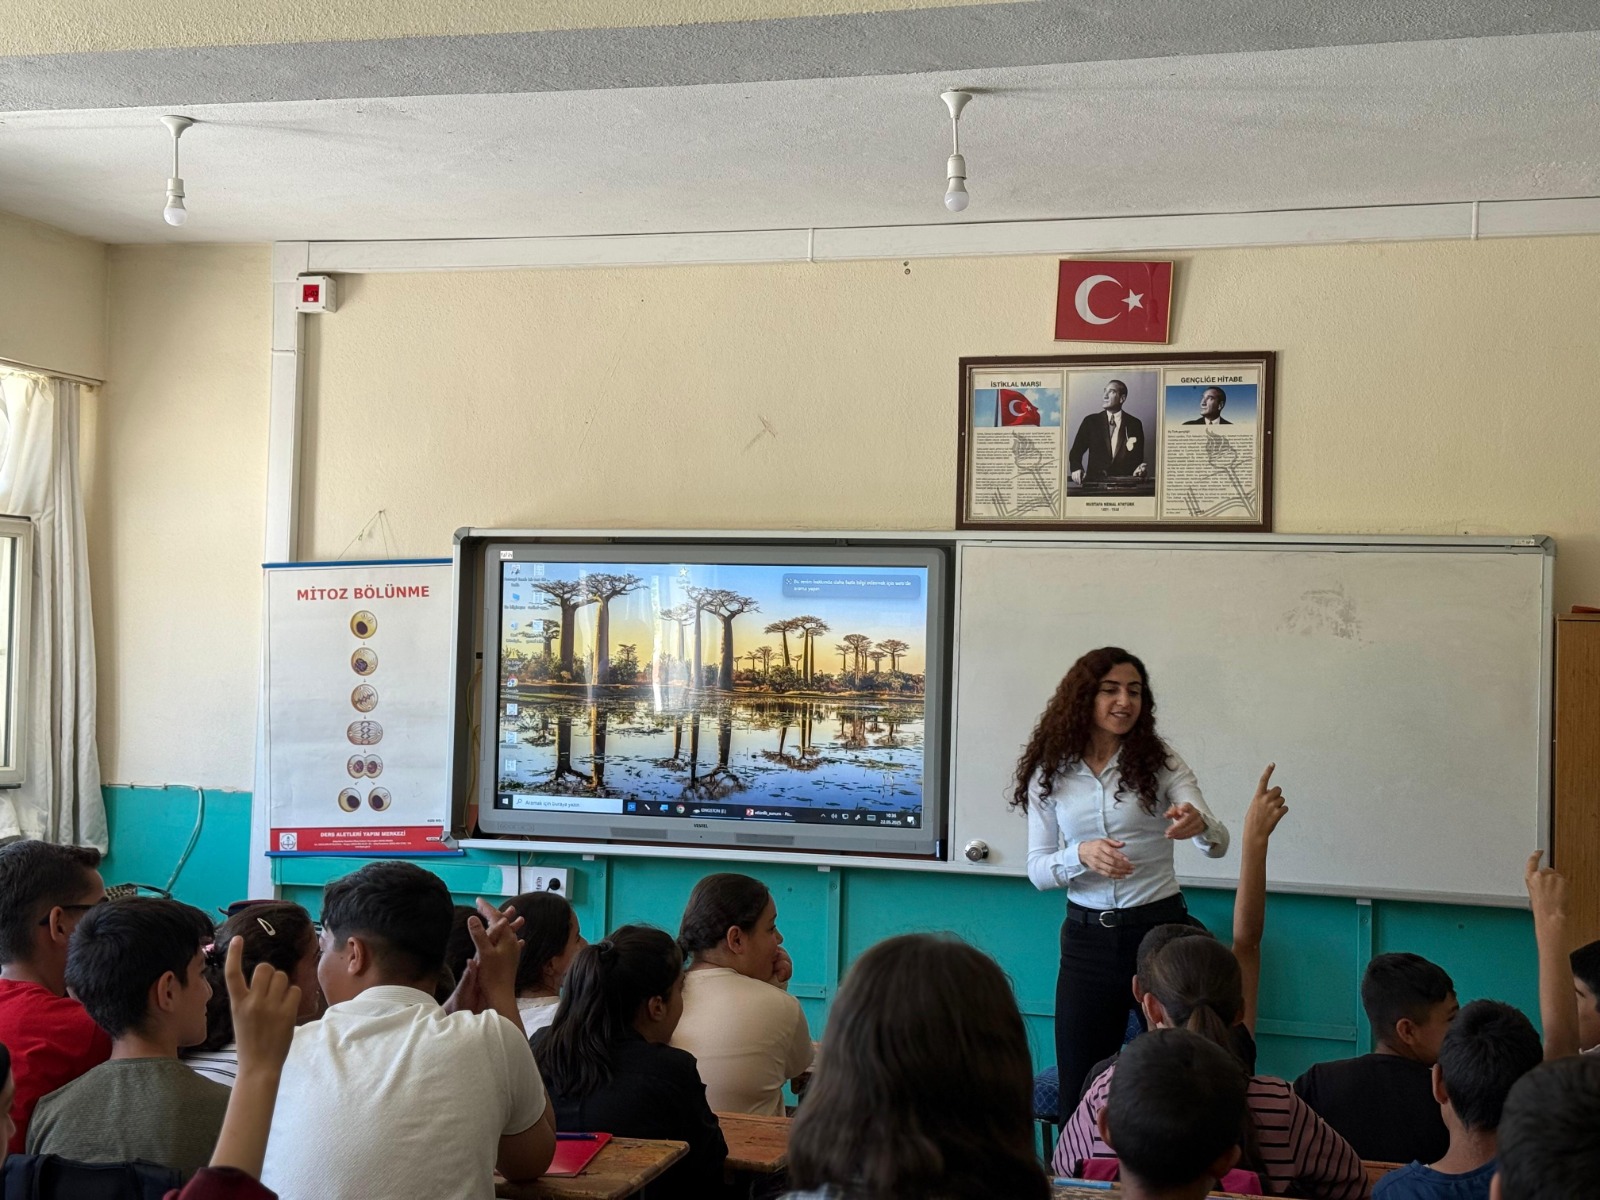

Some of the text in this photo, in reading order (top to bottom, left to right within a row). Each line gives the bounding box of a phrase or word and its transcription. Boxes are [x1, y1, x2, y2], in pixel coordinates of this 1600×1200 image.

[1181, 375, 1243, 384] GENÇLİĞE HİTABE
[297, 583, 430, 601] MİTOZ BÖLÜNME
